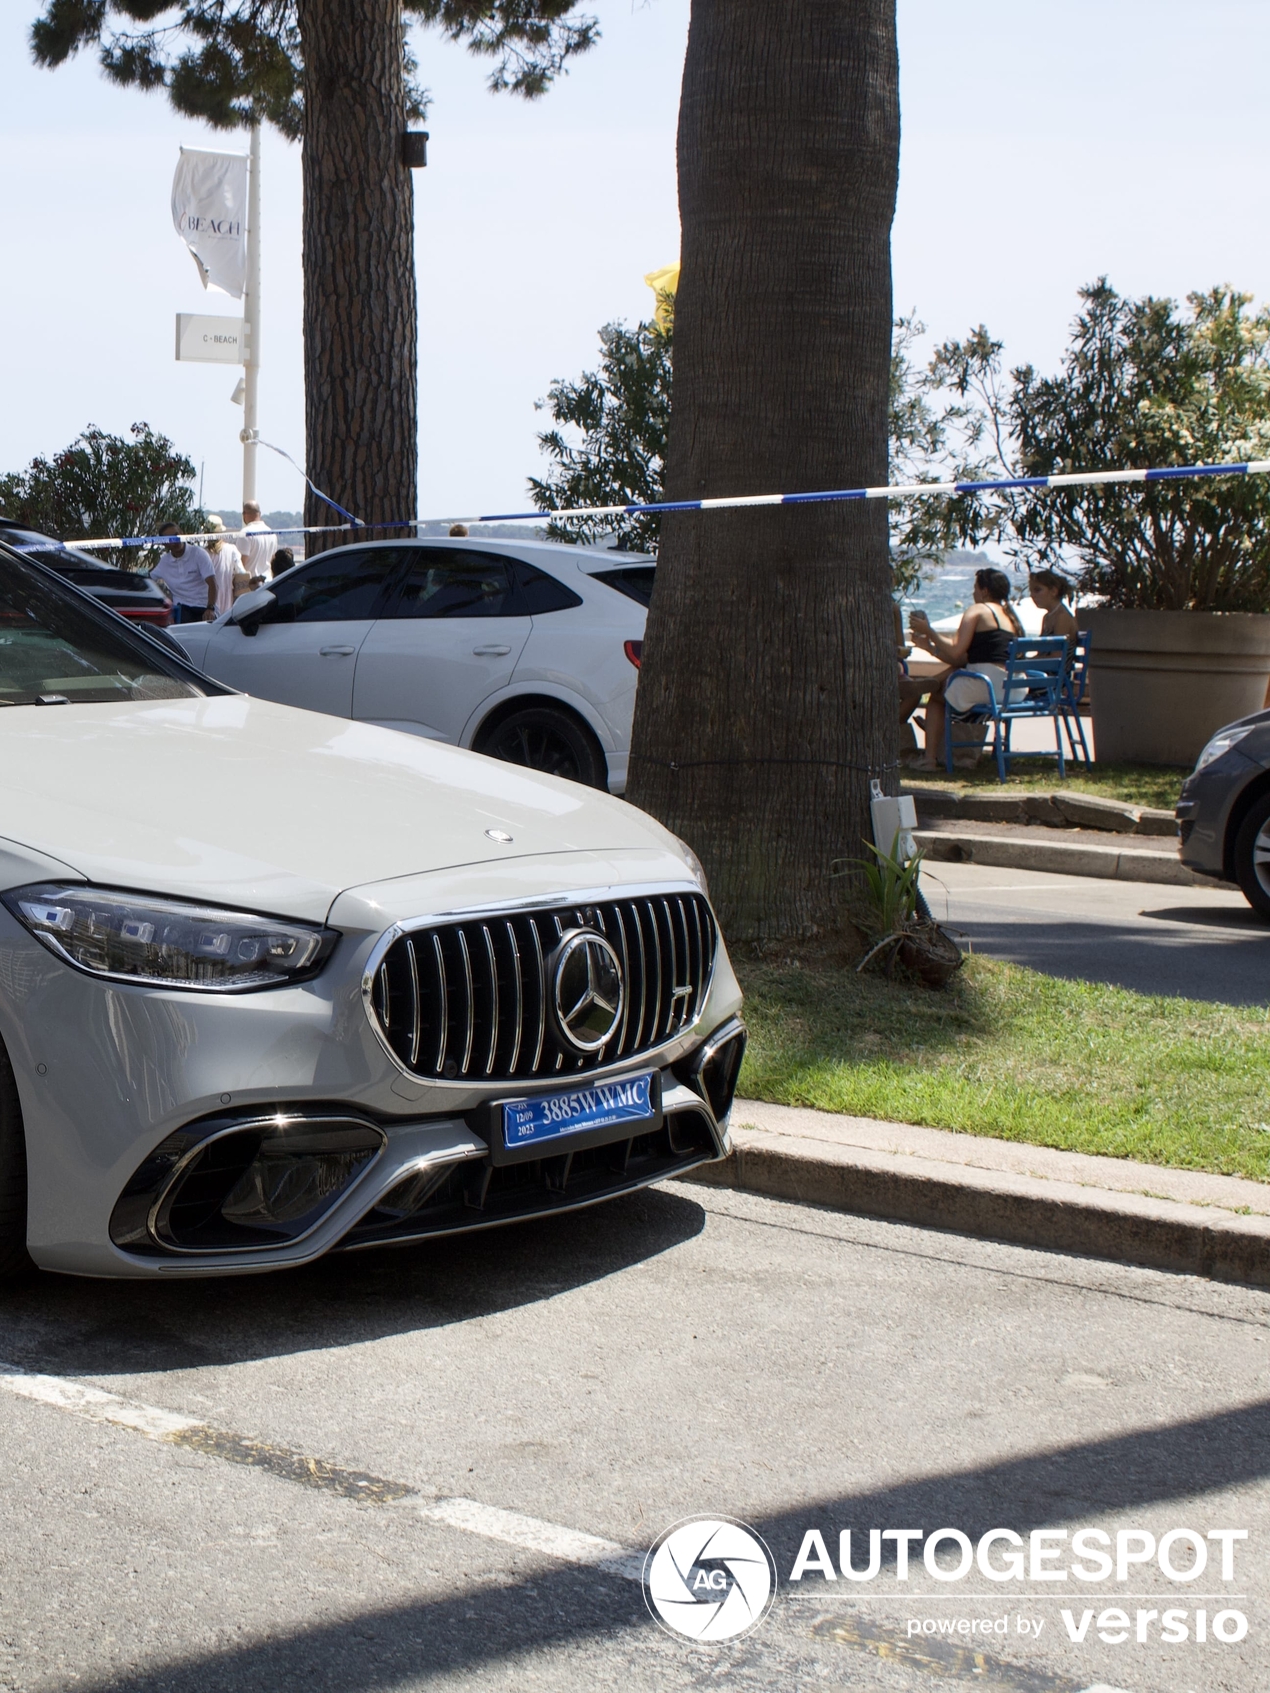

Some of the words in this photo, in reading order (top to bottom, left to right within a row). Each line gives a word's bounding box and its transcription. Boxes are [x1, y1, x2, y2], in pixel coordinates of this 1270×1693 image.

[188, 216, 240, 236] BEACH
[203, 334, 208, 343] C
[214, 335, 238, 345] BEACH
[540, 1081, 645, 1125] 3885WWMC
[516, 1111, 533, 1123] 12/09
[518, 1123, 535, 1136] 2023
